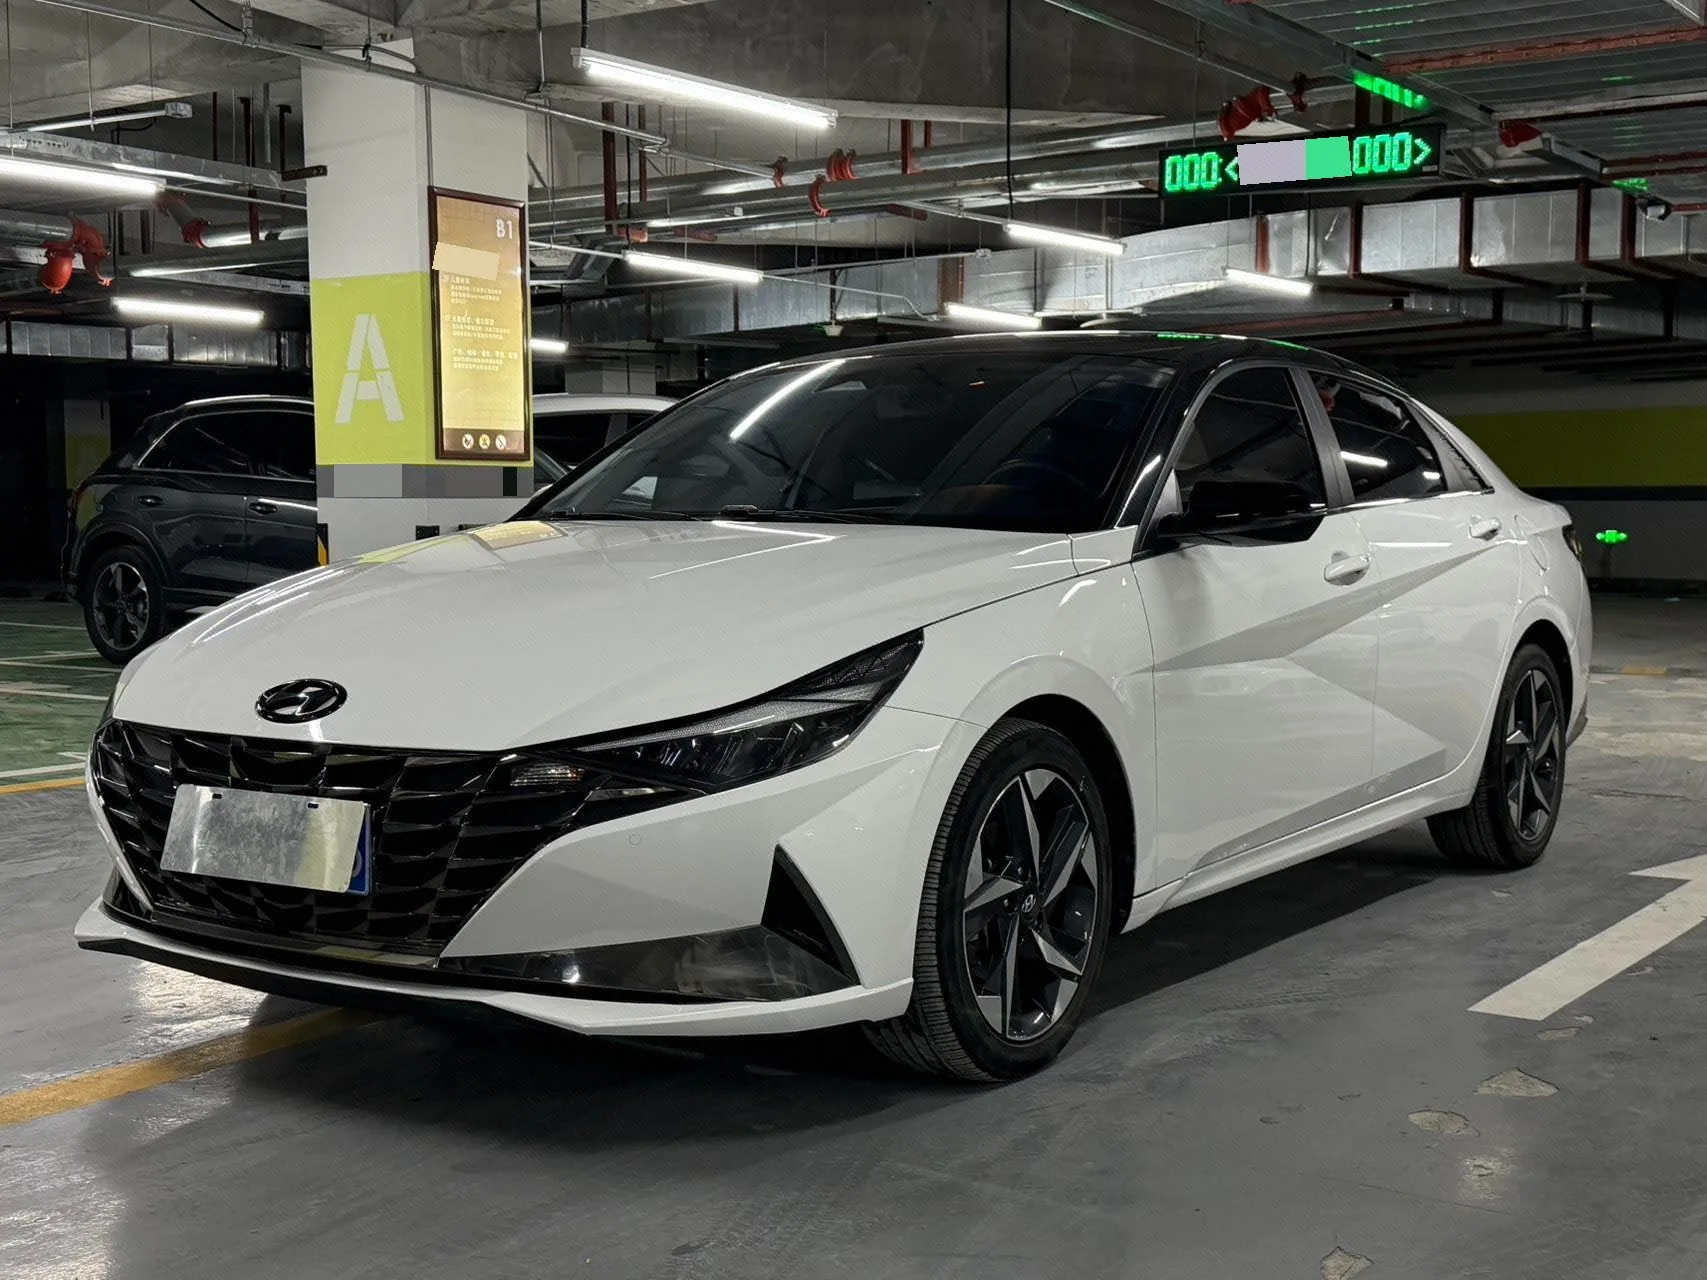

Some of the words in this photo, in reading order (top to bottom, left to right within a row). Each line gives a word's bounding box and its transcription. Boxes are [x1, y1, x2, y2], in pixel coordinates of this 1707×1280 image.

[1352, 132, 1412, 174] 000
[496, 218, 513, 239] B1
[335, 313, 405, 424] A
